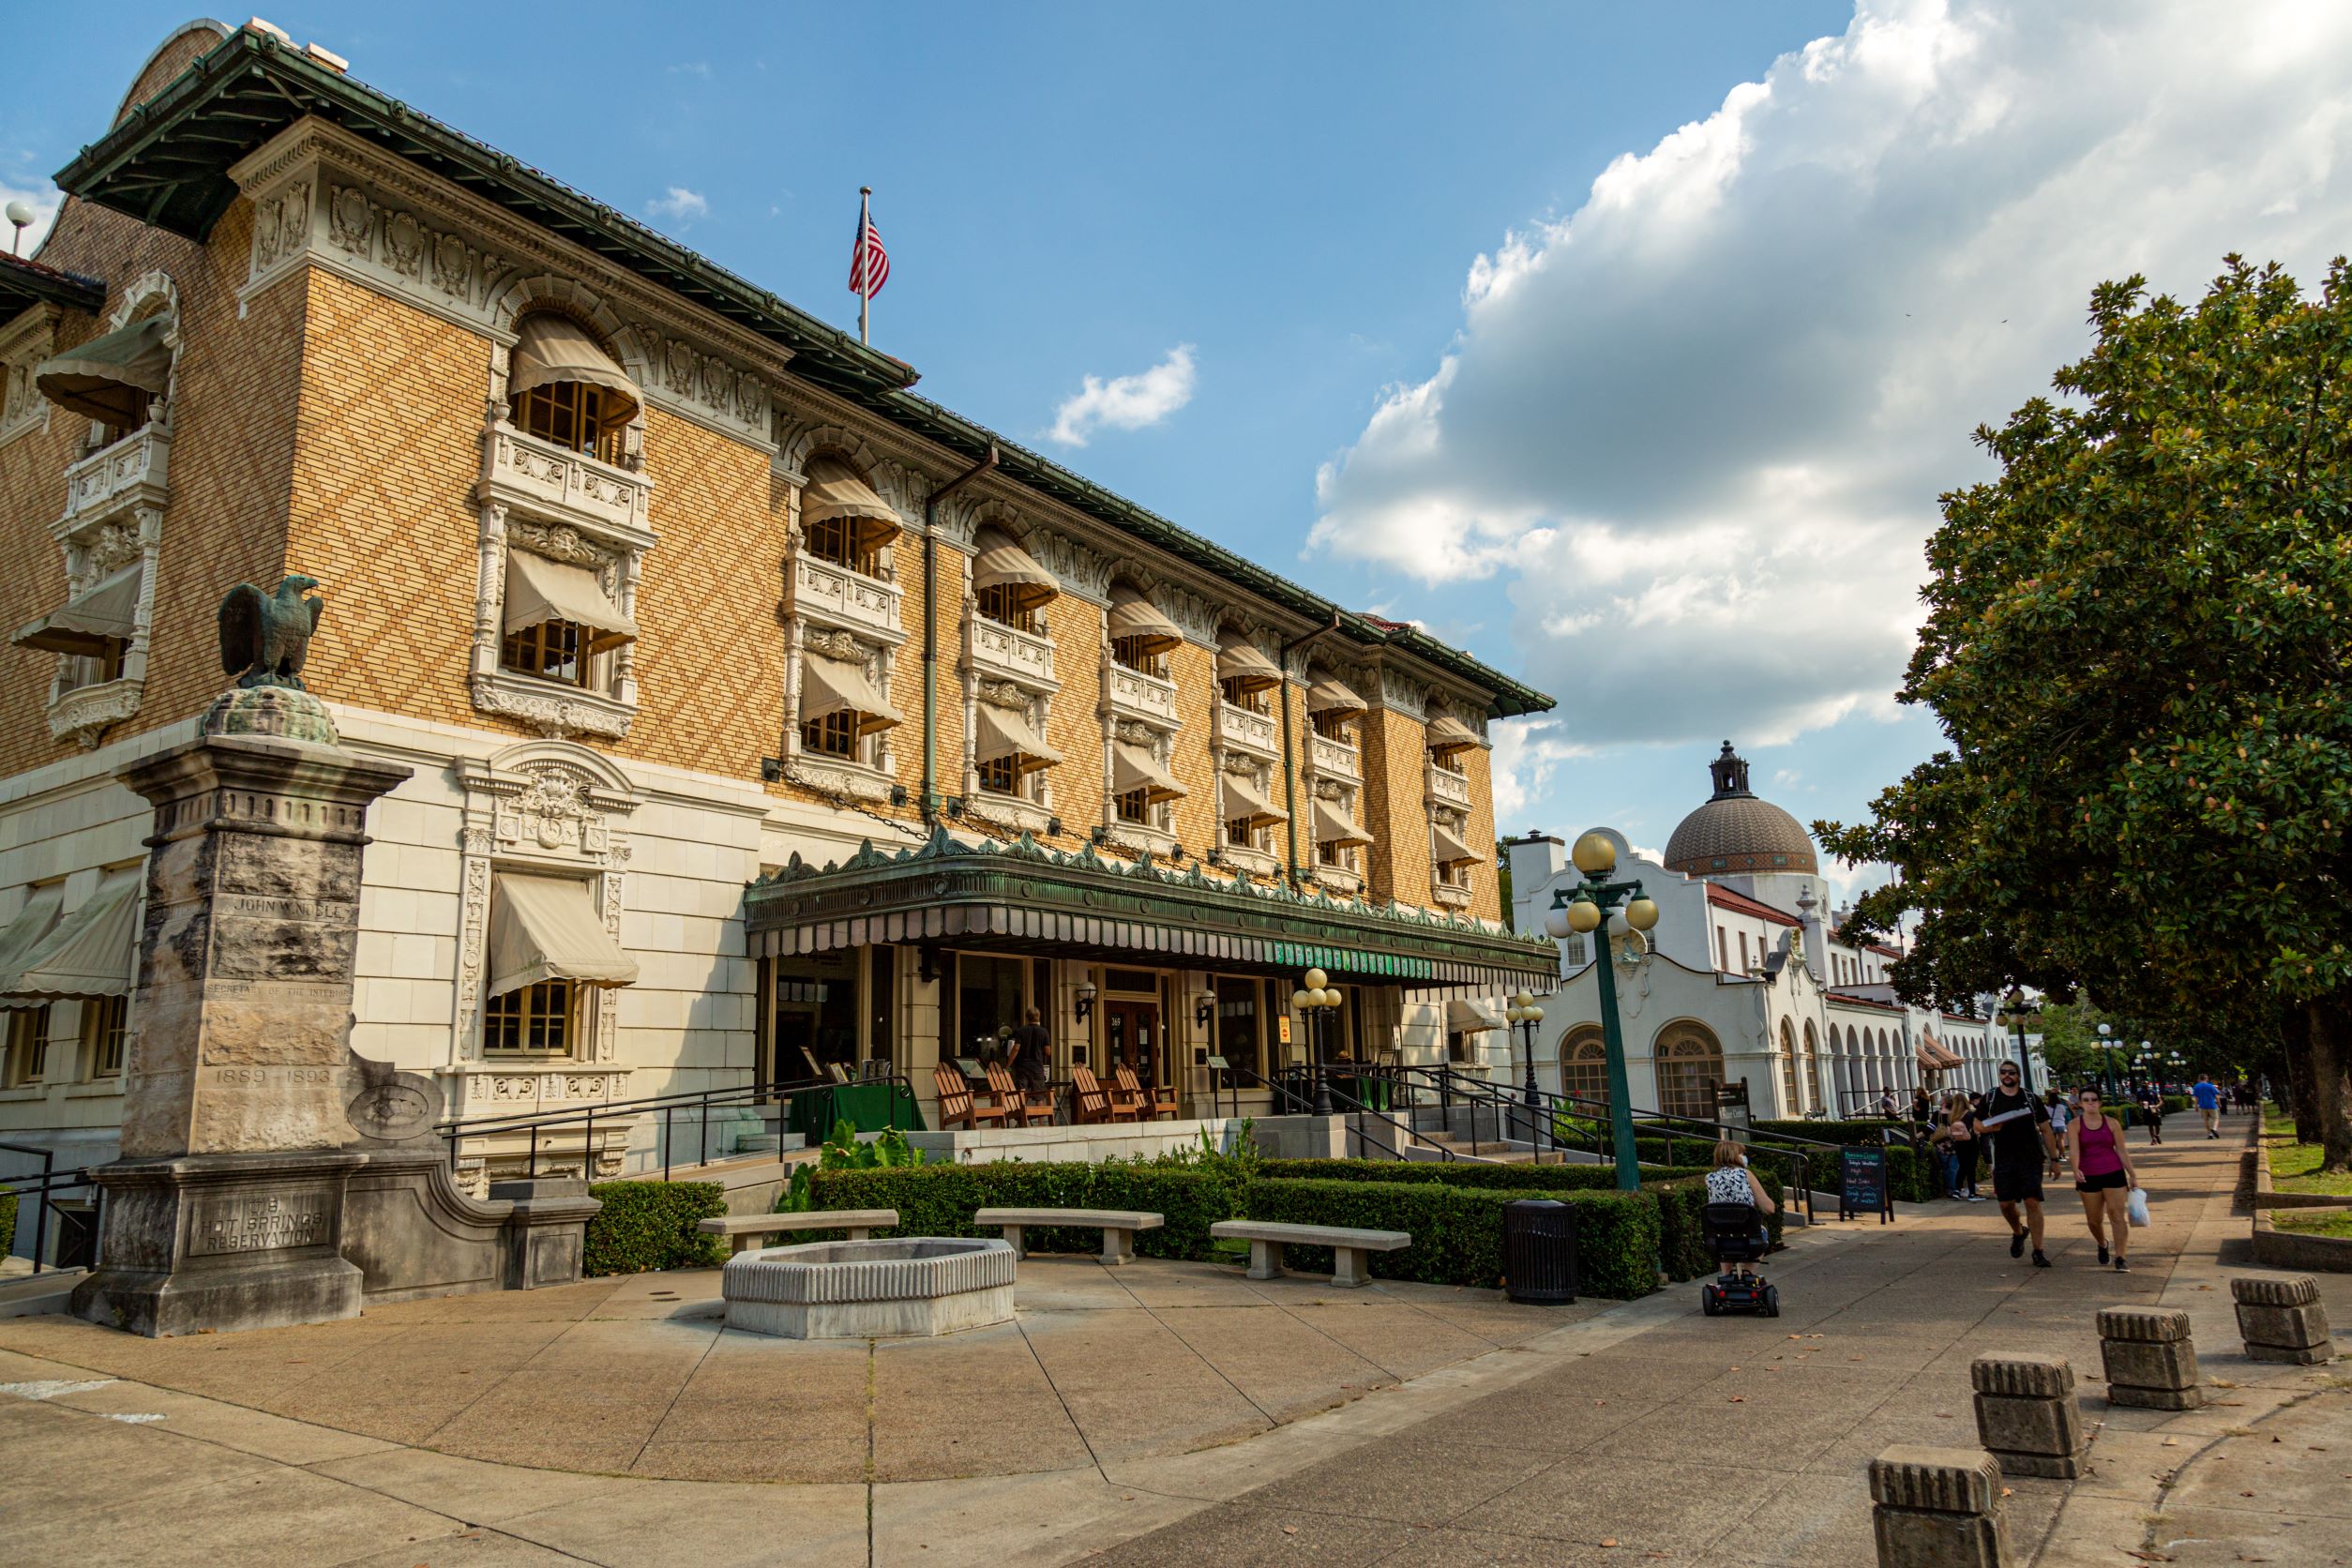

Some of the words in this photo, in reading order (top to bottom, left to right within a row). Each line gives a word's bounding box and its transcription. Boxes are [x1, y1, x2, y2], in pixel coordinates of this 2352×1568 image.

[234, 897, 276, 912] JOHN
[1274, 942, 1342, 970] FORDYCE
[1394, 957, 1431, 979] HOUSE
[206, 983, 264, 996] SECRETARY
[268, 987, 280, 996] OF
[287, 988, 305, 997] THE
[1111, 1018, 1121, 1026] 369
[216, 1068, 266, 1083] 1889
[201, 1219, 238, 1234] HOT
[247, 1212, 323, 1230] SPRINGS
